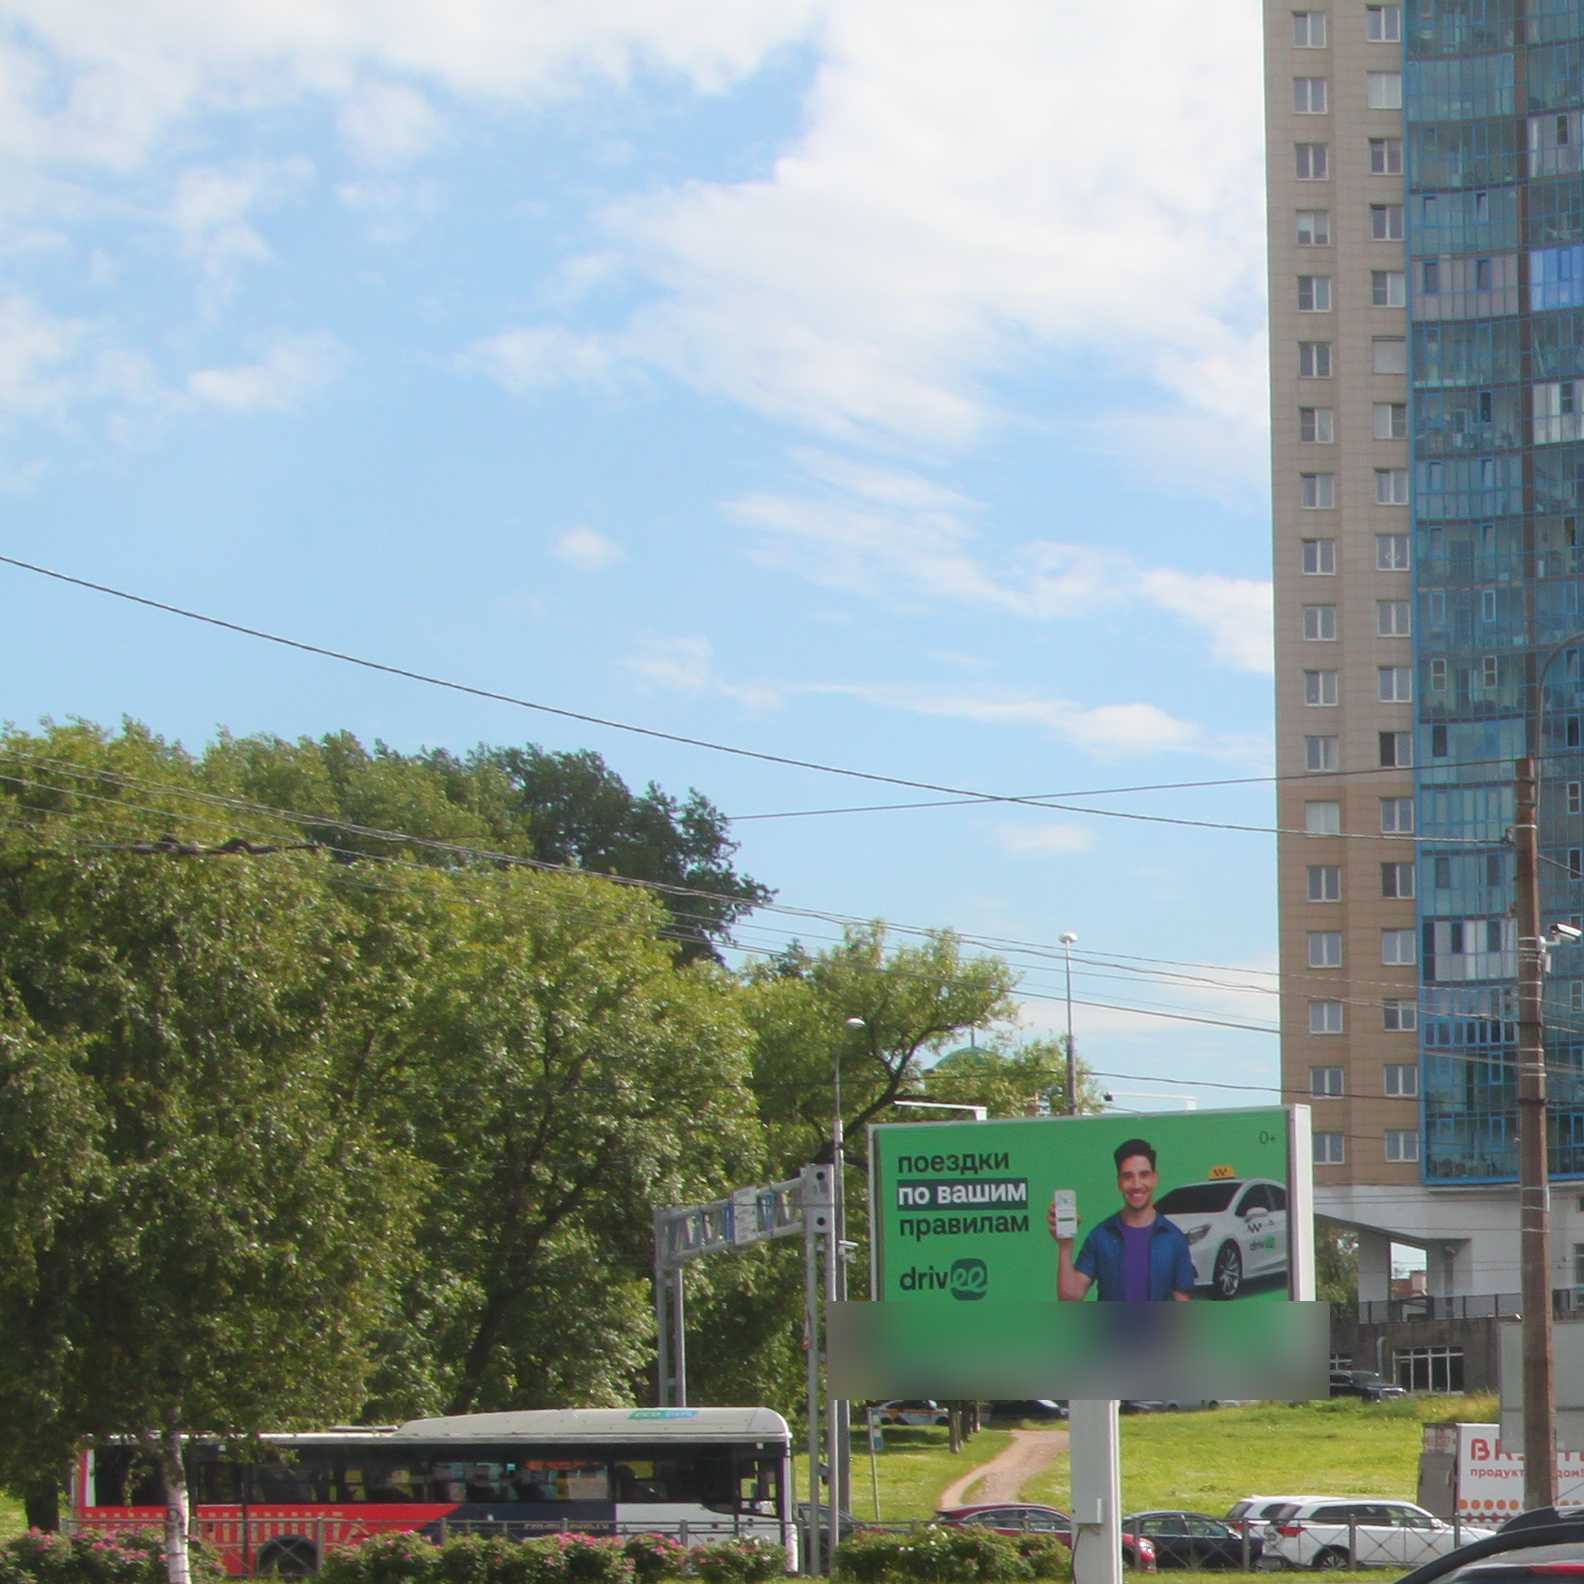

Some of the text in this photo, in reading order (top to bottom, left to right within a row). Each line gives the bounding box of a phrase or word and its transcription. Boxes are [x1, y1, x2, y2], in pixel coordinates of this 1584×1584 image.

[898, 1151, 1010, 1175] поездки
[898, 1182, 1027, 1206] по вашим
[899, 1213, 1030, 1242] правилам
[899, 1262, 988, 1295] drivee
